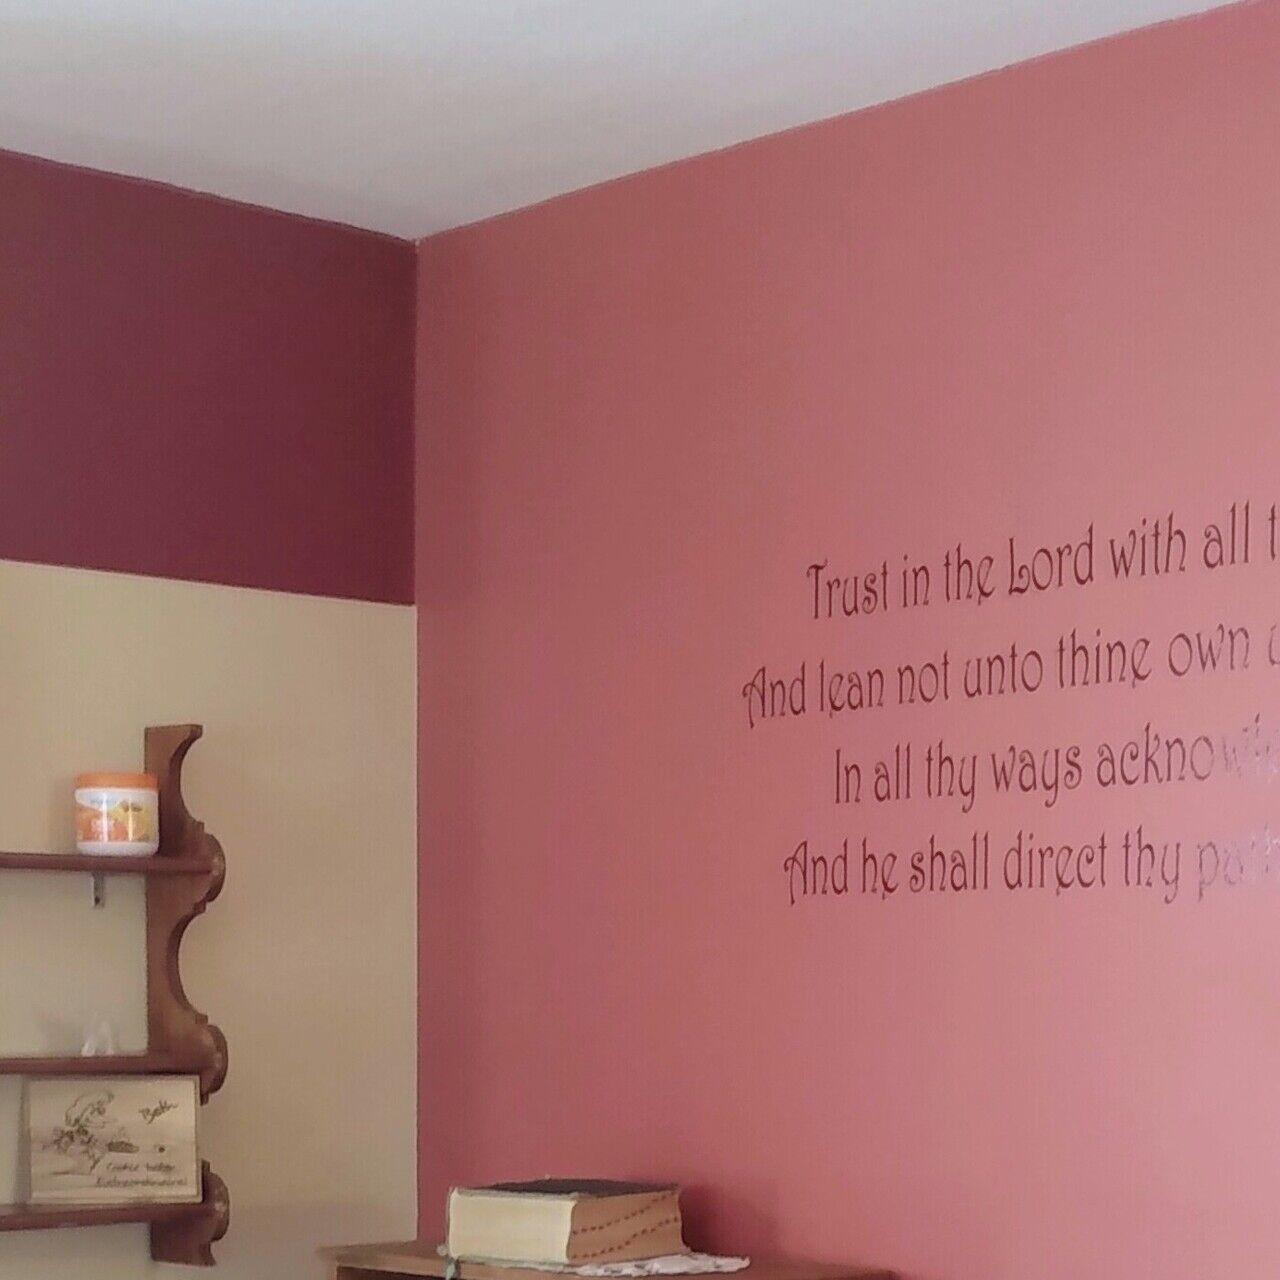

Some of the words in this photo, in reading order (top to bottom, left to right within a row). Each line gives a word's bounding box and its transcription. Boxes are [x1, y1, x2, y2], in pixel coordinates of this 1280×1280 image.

[807, 559, 888, 619] Trust
[901, 554, 930, 609] in
[944, 543, 995, 605] the
[1008, 521, 1094, 595] Lord
[1109, 510, 1187, 579] with
[1203, 500, 1249, 569] all
[742, 662, 806, 729] And
[819, 661, 884, 718] lean
[898, 650, 950, 704] not
[963, 642, 1044, 699] unto
[1058, 628, 1151, 689] thine
[1168, 621, 1250, 677] own
[835, 748, 861, 804] In
[874, 742, 911, 801] all
[926, 739, 978, 813] thy
[991, 744, 1082, 807] ways
[784, 838, 848, 906] And
[862, 837, 900, 900] he
[909, 830, 989, 893] shall
[1003, 830, 1108, 896] direct
[1122, 824, 1181, 904] thy
